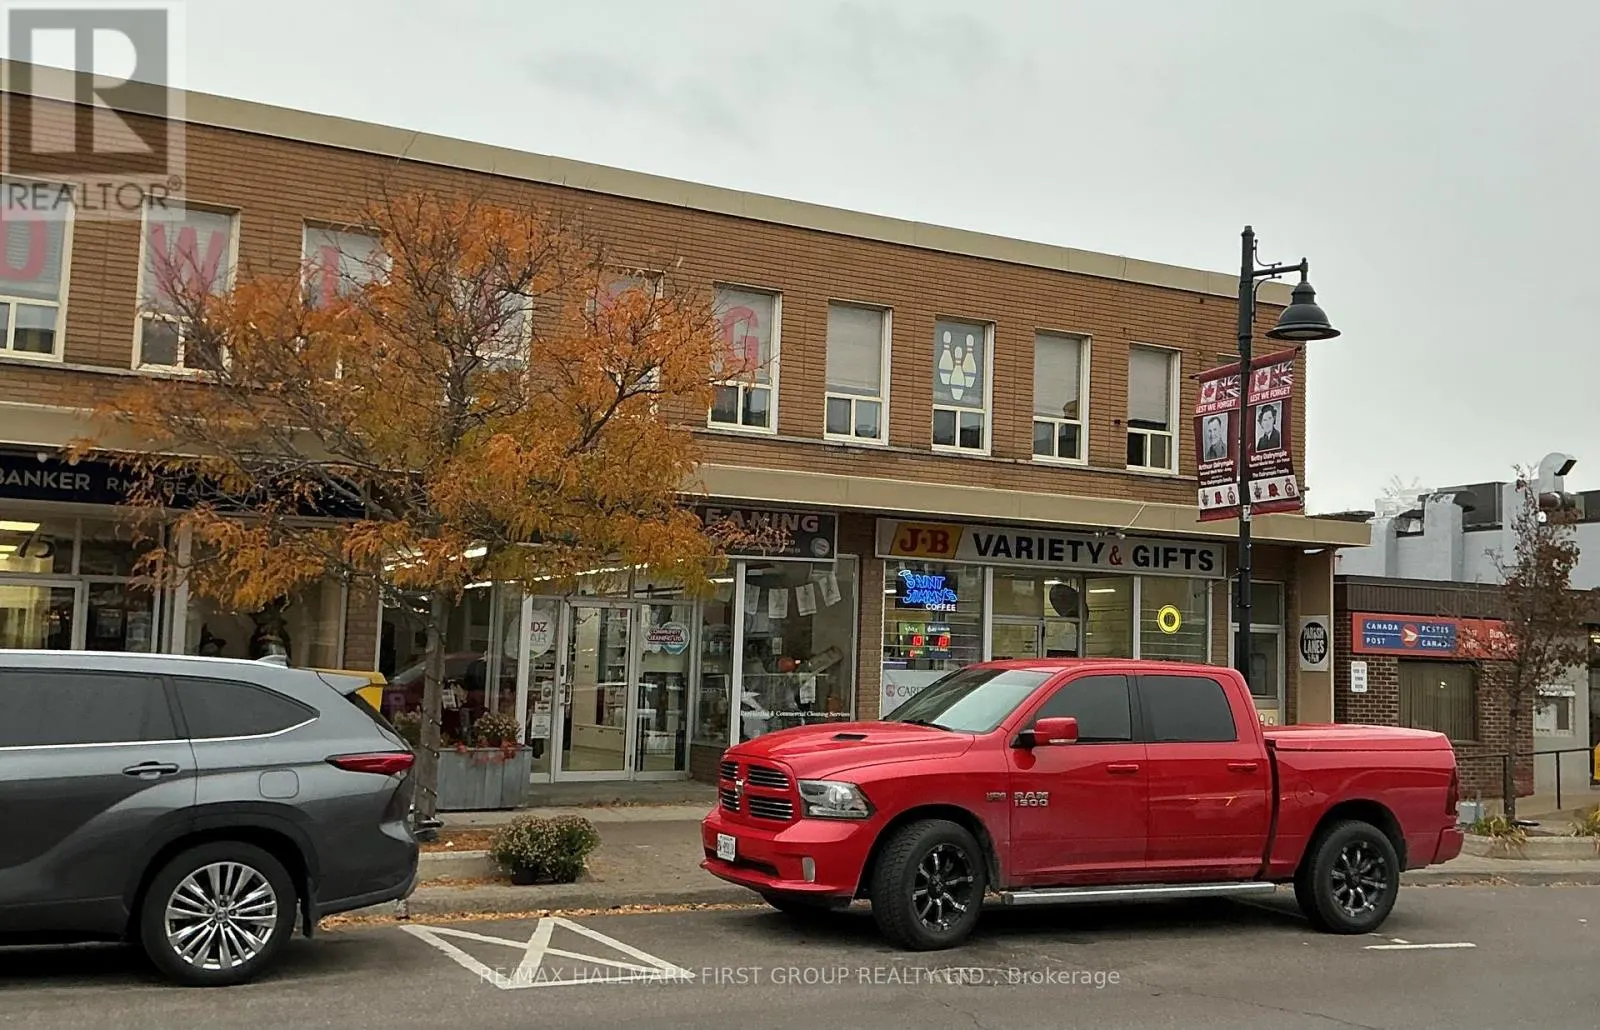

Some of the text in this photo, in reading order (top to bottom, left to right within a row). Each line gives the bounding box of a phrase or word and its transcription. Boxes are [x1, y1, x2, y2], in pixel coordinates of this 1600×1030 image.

[1250, 386, 1291, 402] LEST WE FORGET
[1208, 401, 1217, 411] WE
[1217, 398, 1236, 410] FORGET
[17, 532, 56, 559] 75
[973, 533, 1105, 564] VARIETY
[1109, 545, 1124, 566] &
[1132, 546, 1214, 571] GIFTS
[925, 603, 956, 611] COFFEE
[531, 622, 548, 632] IDZ
[1366, 622, 1399, 631] CANADA
[1421, 625, 1449, 634] POSTES
[1366, 637, 1386, 645] POST
[1421, 639, 1451, 648] CANAD
[1303, 640, 1325, 653] LANES
[1014, 791, 1049, 799] RAM
[1014, 799, 1049, 807] 1500
